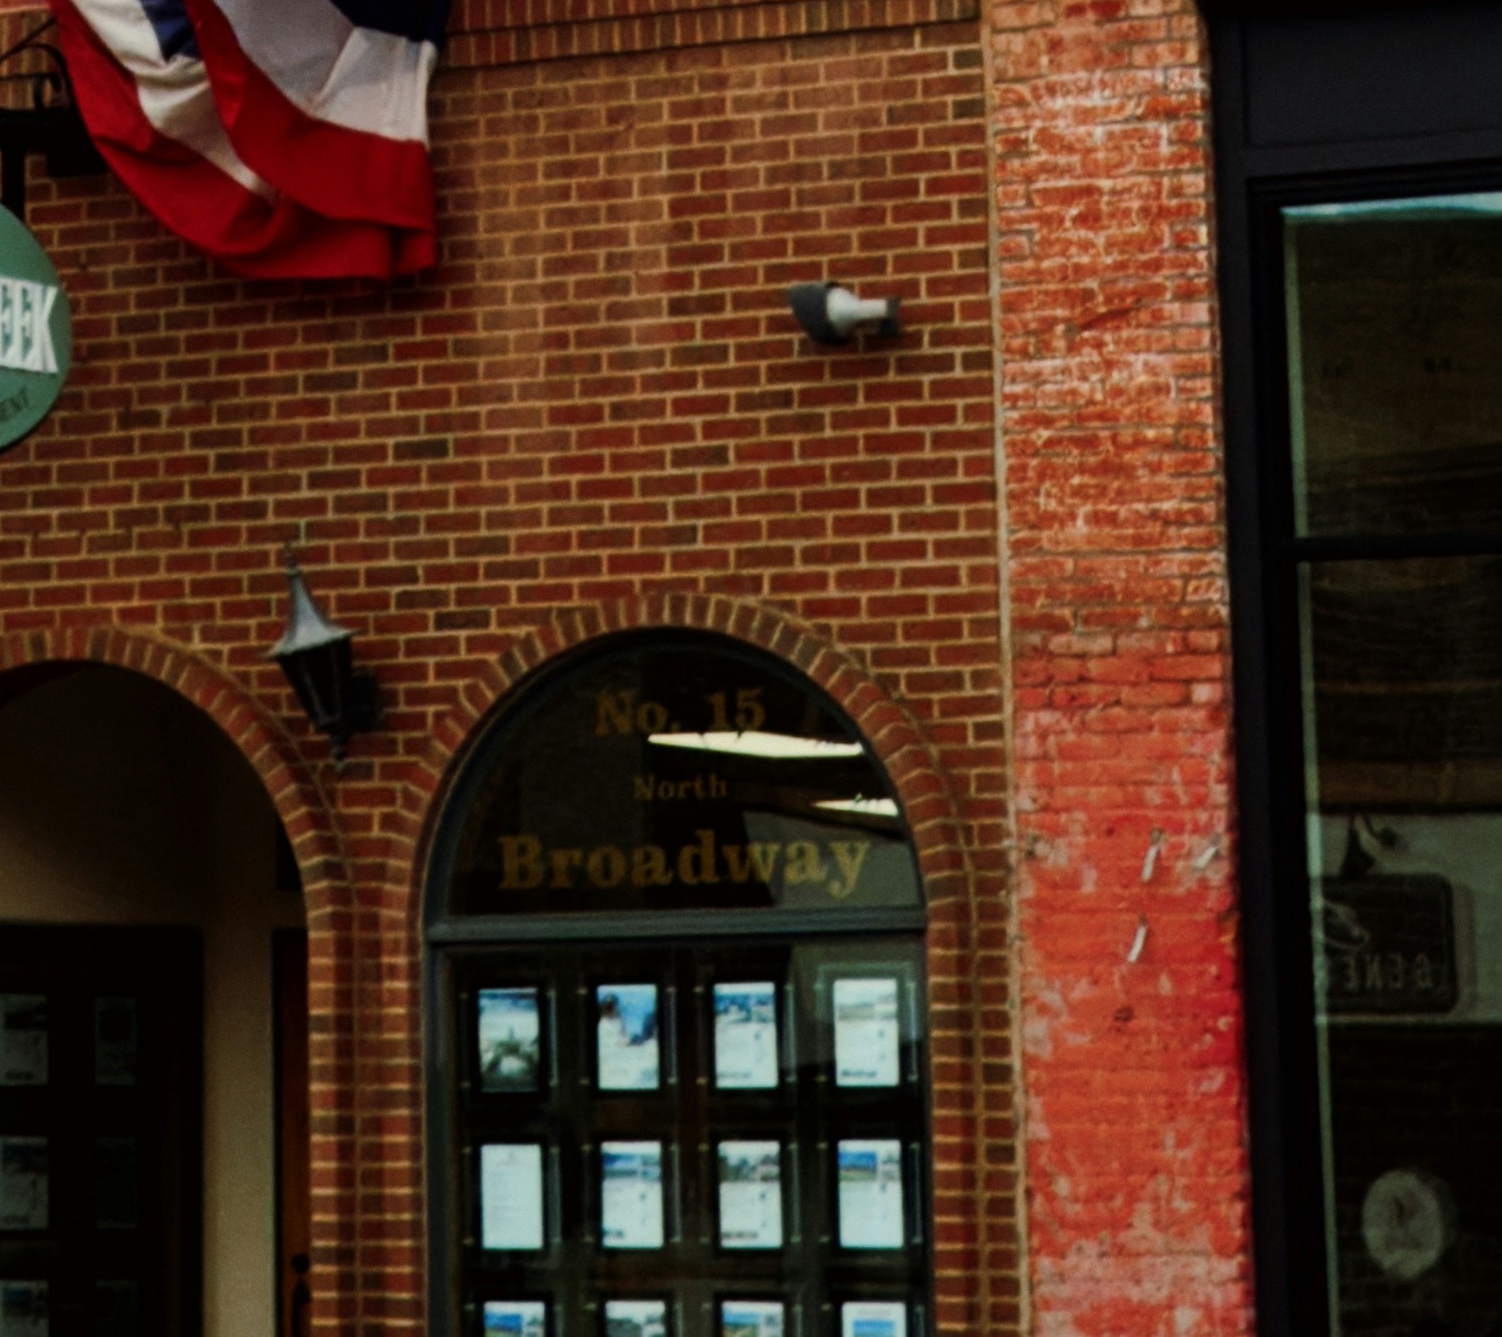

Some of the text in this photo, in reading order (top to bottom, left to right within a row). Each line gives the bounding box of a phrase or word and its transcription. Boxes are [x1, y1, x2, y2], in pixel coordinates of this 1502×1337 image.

[594, 687, 767, 735] No. 15
[632, 772, 729, 802] North
[499, 829, 872, 899] Broadway
